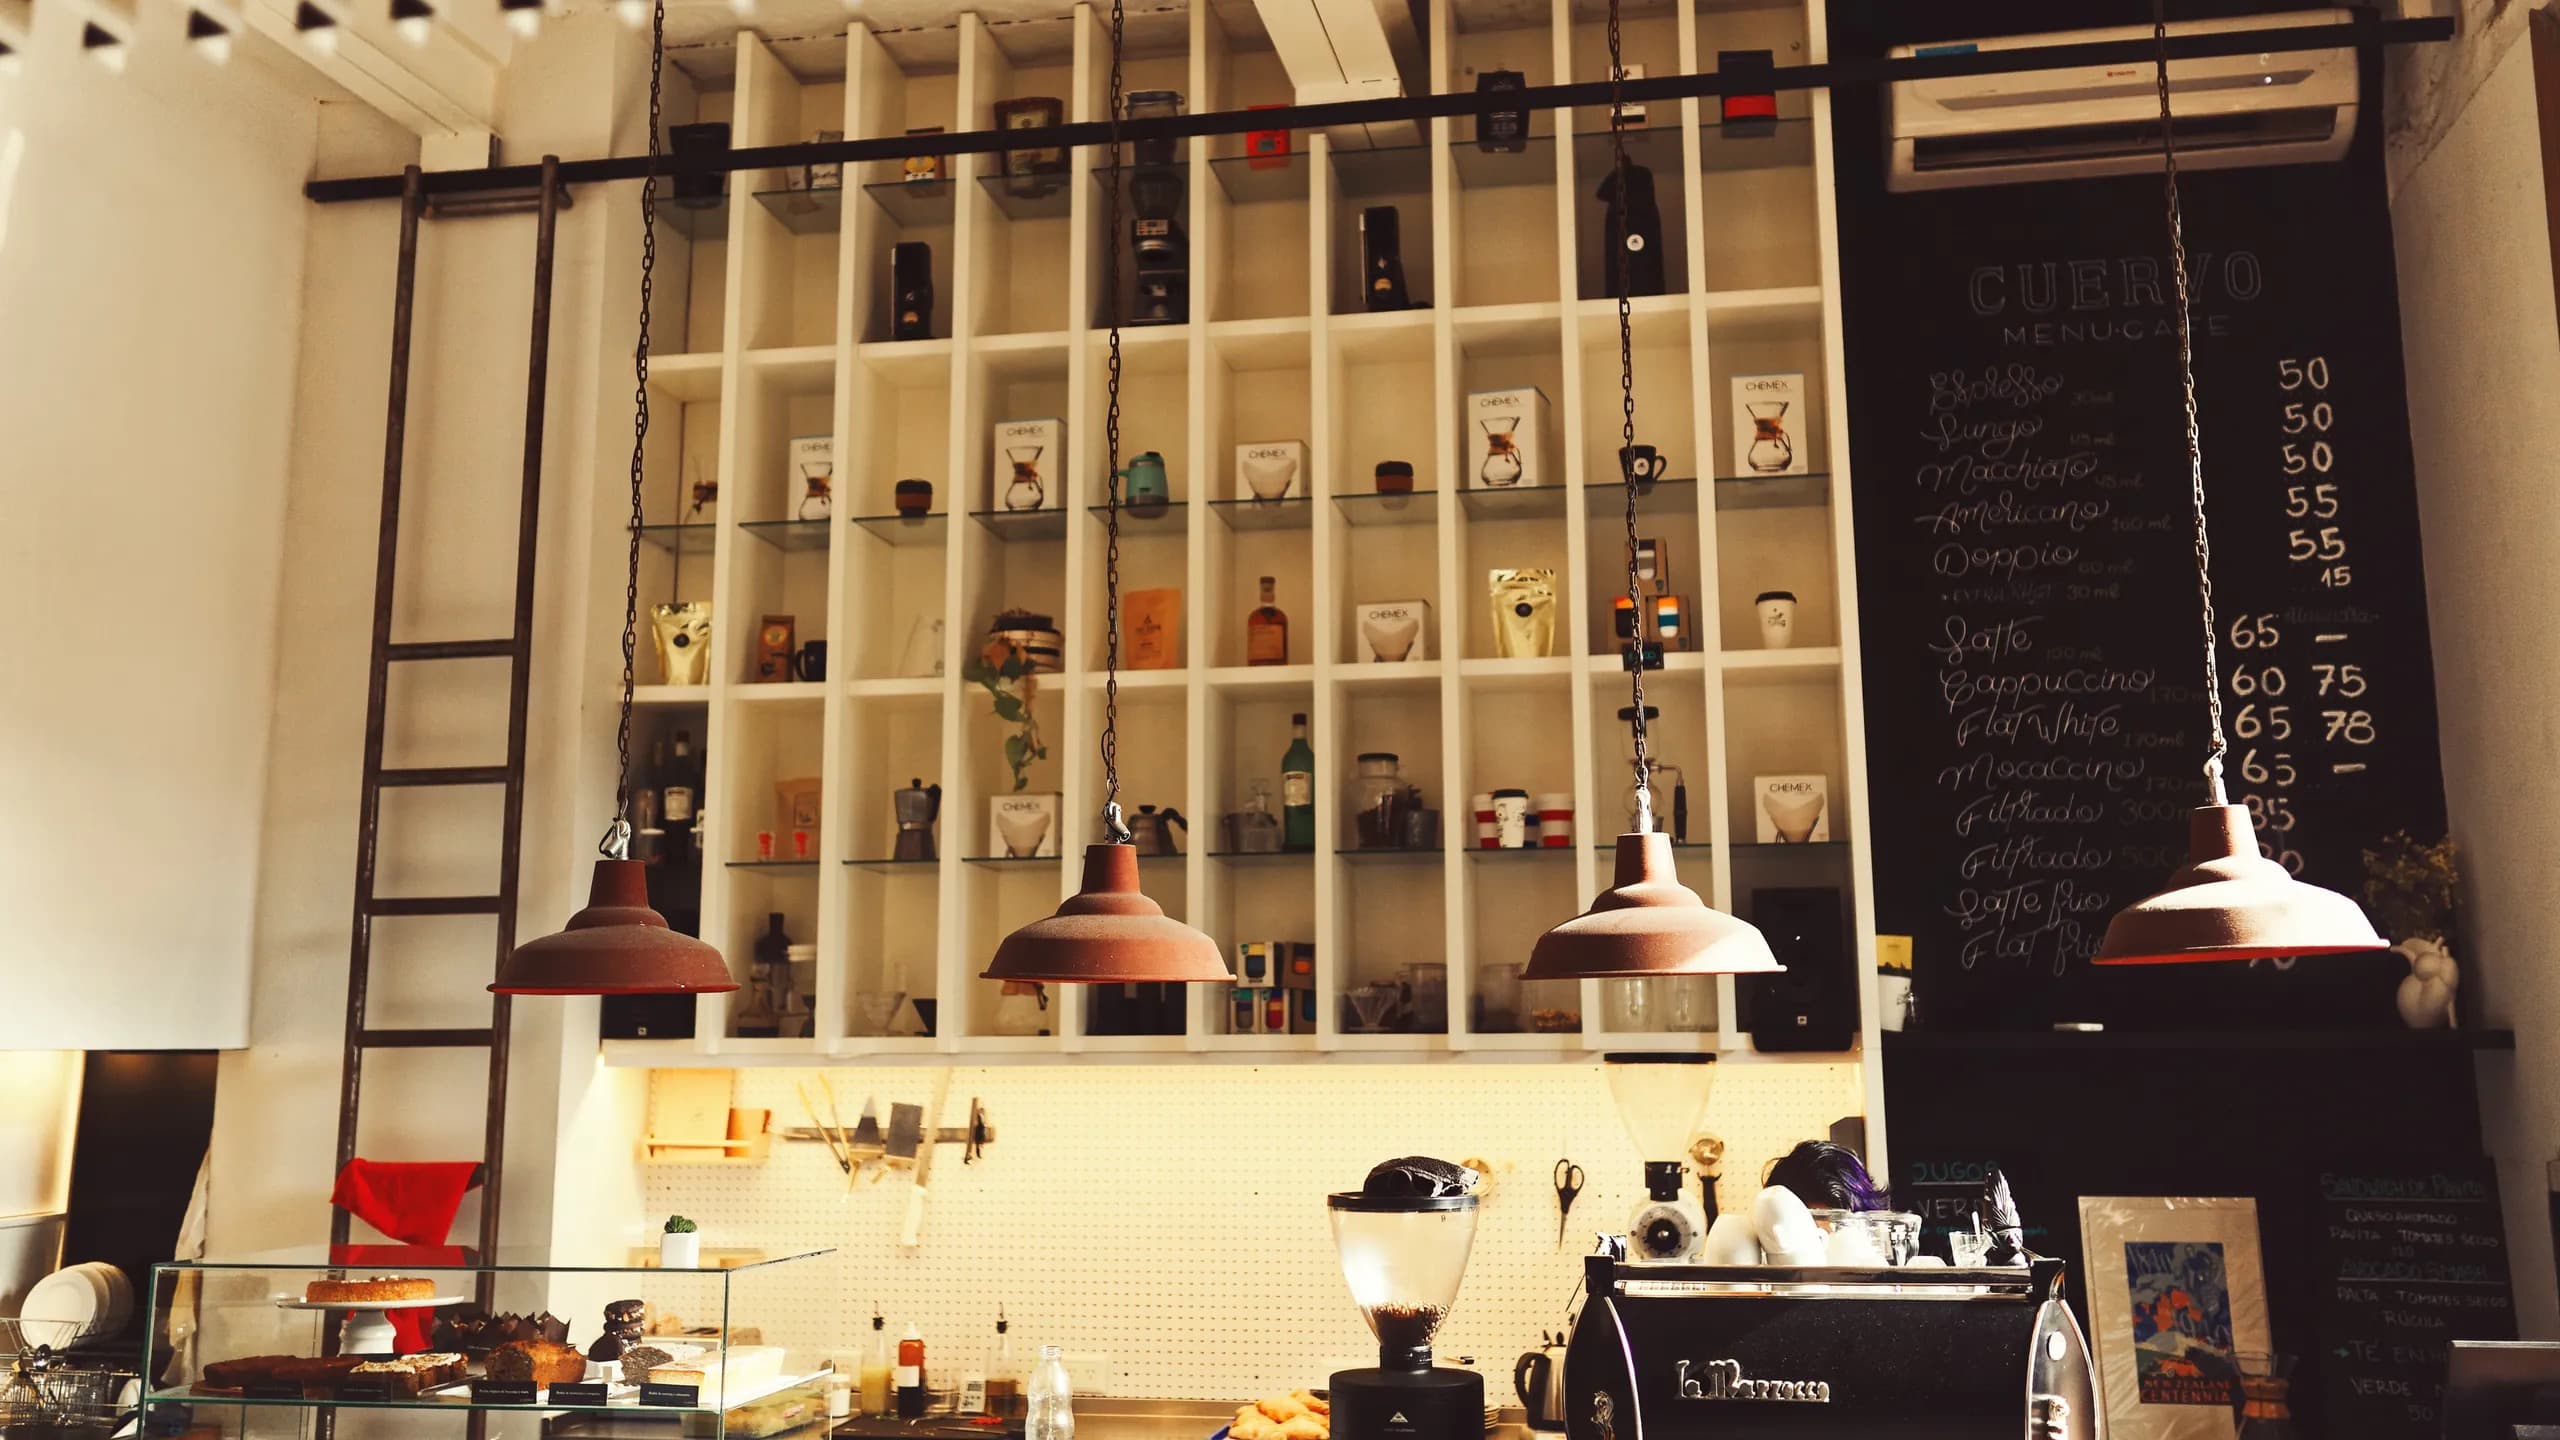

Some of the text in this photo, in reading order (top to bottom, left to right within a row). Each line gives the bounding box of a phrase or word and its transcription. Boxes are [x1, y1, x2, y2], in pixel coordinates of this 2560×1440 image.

[1968, 250, 2262, 315] CUERVO
[1745, 379, 1788, 392] CHEMEX
[2279, 356, 2329, 390] 50
[2283, 402, 2334, 434] 50
[801, 442, 830, 452] CHEME
[1920, 412, 2044, 460] Lungo
[2282, 440, 2334, 475] 50
[2286, 483, 2339, 518] 55
[2288, 526, 2346, 561] 55
[1934, 542, 2080, 582] Doppio
[2320, 565, 2352, 588] 15
[2230, 613, 2280, 650] 65
[2231, 663, 2368, 698] 60 75
[2235, 703, 2376, 744] 65 78
[2241, 749, 2297, 787] 65
[1769, 782, 1813, 794] CHEMEX
[2349, 1376, 2414, 1398] VERDE
